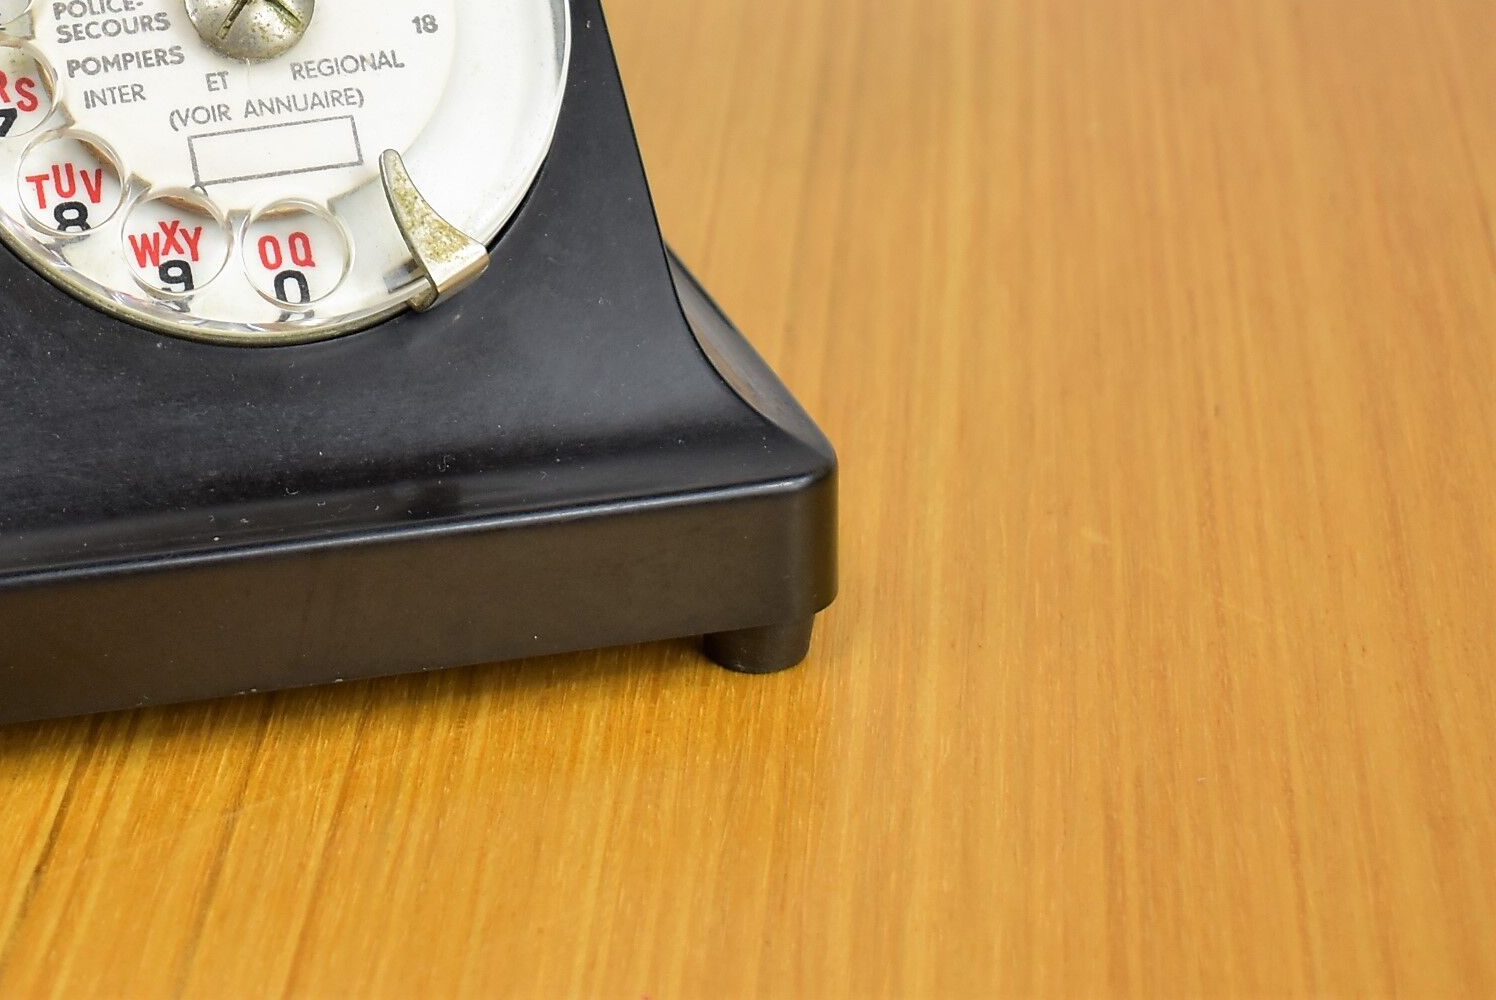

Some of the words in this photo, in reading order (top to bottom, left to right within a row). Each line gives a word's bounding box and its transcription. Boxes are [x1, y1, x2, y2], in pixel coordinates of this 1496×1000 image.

[56, 12, 171, 44] SECOURS
[411, 14, 439, 34] 18
[66, 45, 185, 78] POMPIERS
[84, 83, 146, 109] INTER
[205, 71, 230, 92] ET
[290, 50, 405, 81] REGIONAL
[168, 103, 232, 132] (VOIR
[244, 87, 365, 119] ANNUAIRE)
[25, 163, 102, 209] TUV
[53, 201, 91, 231] 8
[128, 219, 202, 268] WXY
[158, 259, 194, 294] 9
